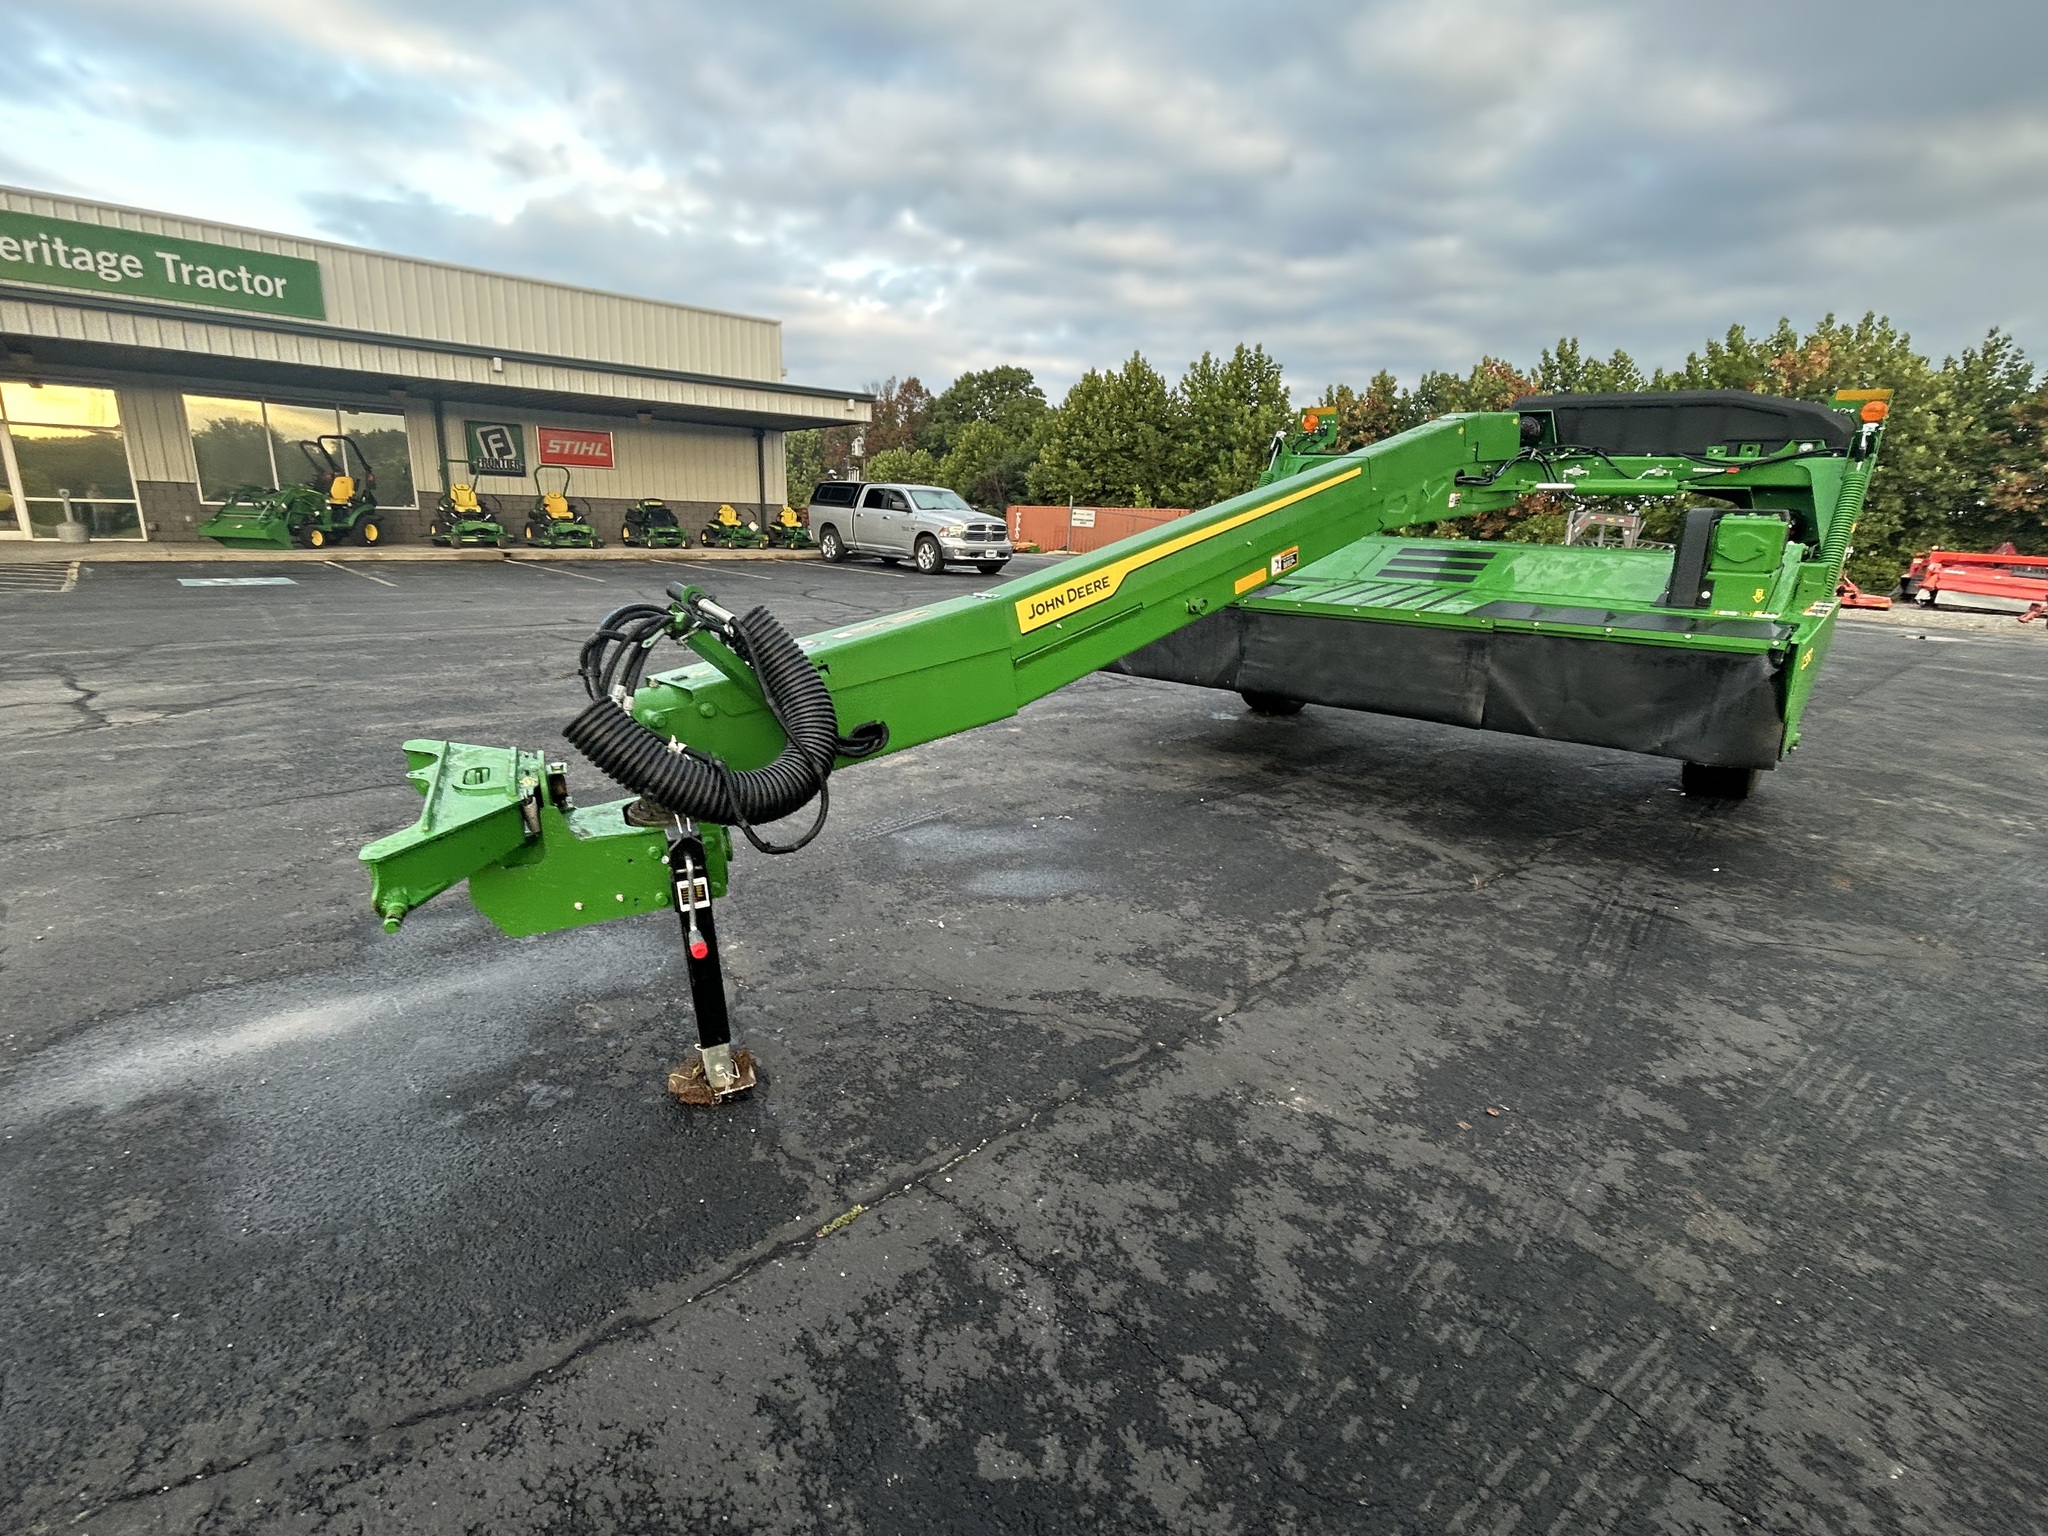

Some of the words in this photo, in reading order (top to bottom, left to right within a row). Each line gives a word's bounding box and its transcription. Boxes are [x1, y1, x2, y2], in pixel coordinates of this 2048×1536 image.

[155, 251, 287, 298] Tractor
[546, 439, 608, 457] STIHL
[478, 457, 521, 471] FRONTIER
